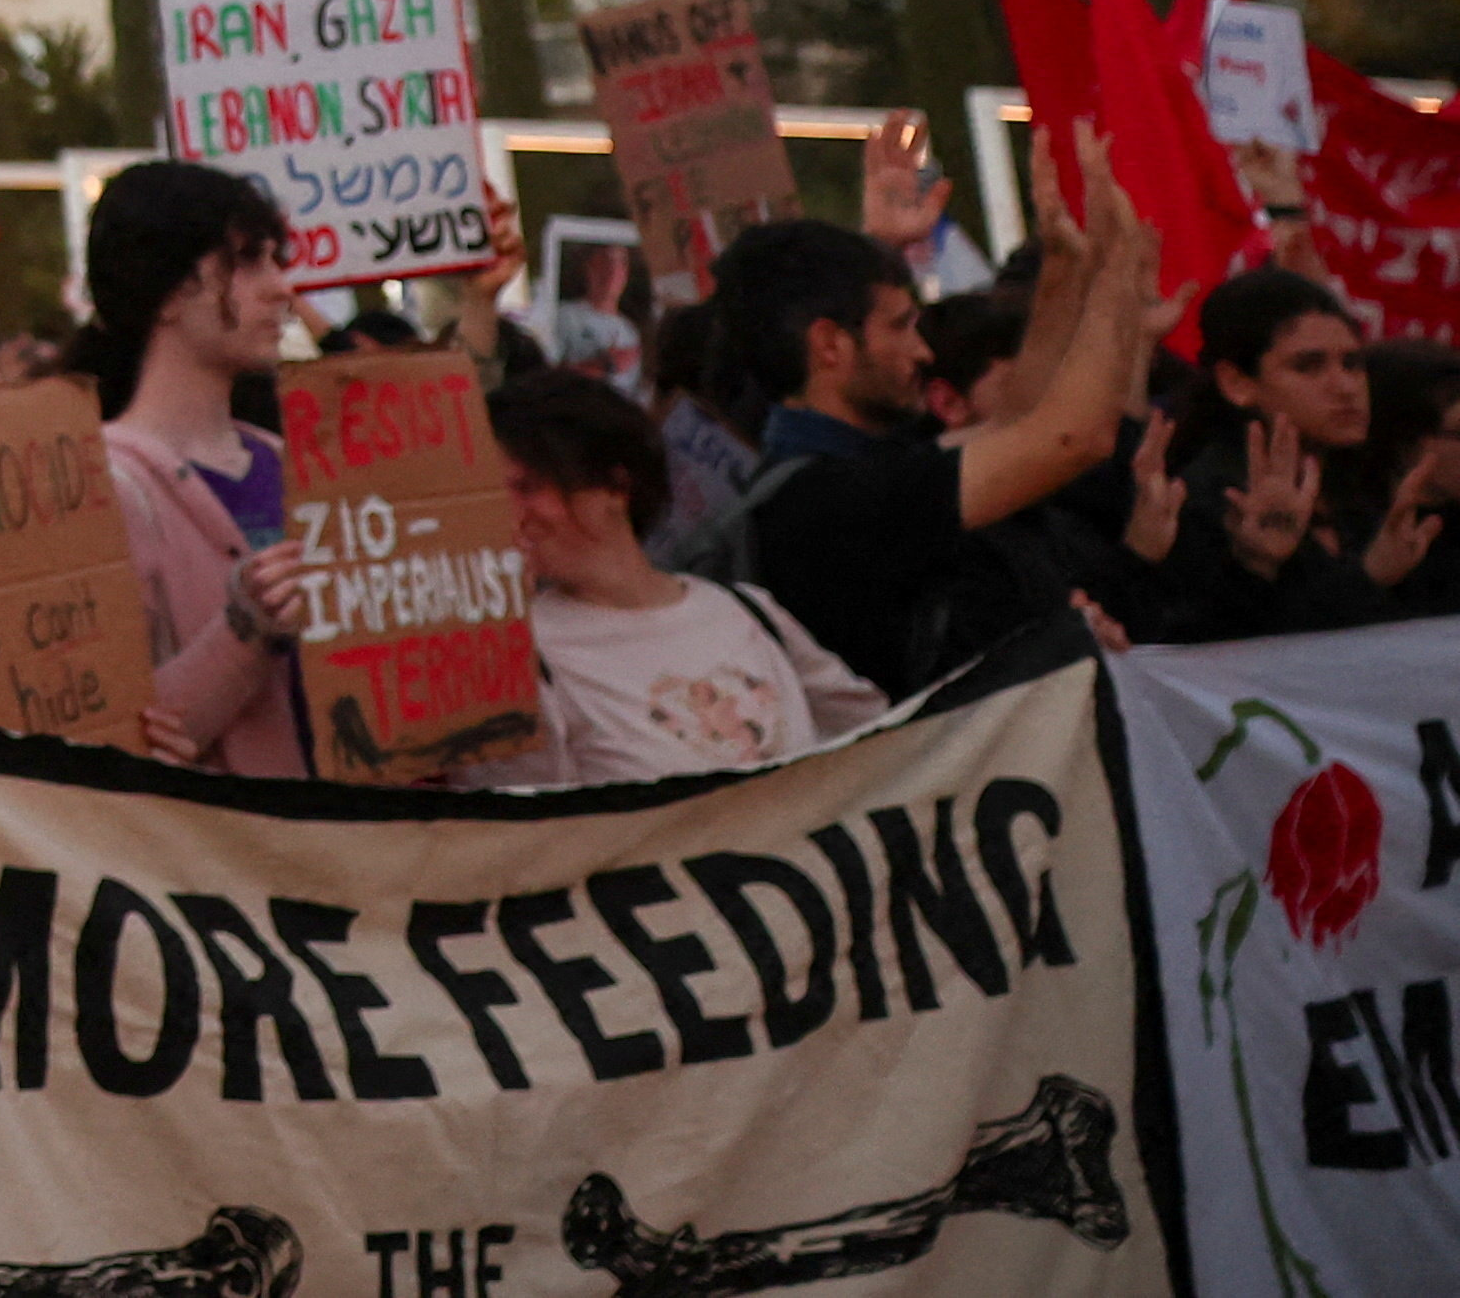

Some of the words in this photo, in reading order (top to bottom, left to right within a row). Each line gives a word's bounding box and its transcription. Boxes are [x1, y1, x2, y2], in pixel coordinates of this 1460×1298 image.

[358, 69, 468, 136] SYRIA
[283, 372, 475, 492] RESIST
[325, 619, 539, 745] TERROR
[405, 775, 1077, 1093] FEEDING
[362, 1223, 517, 1298] THE
